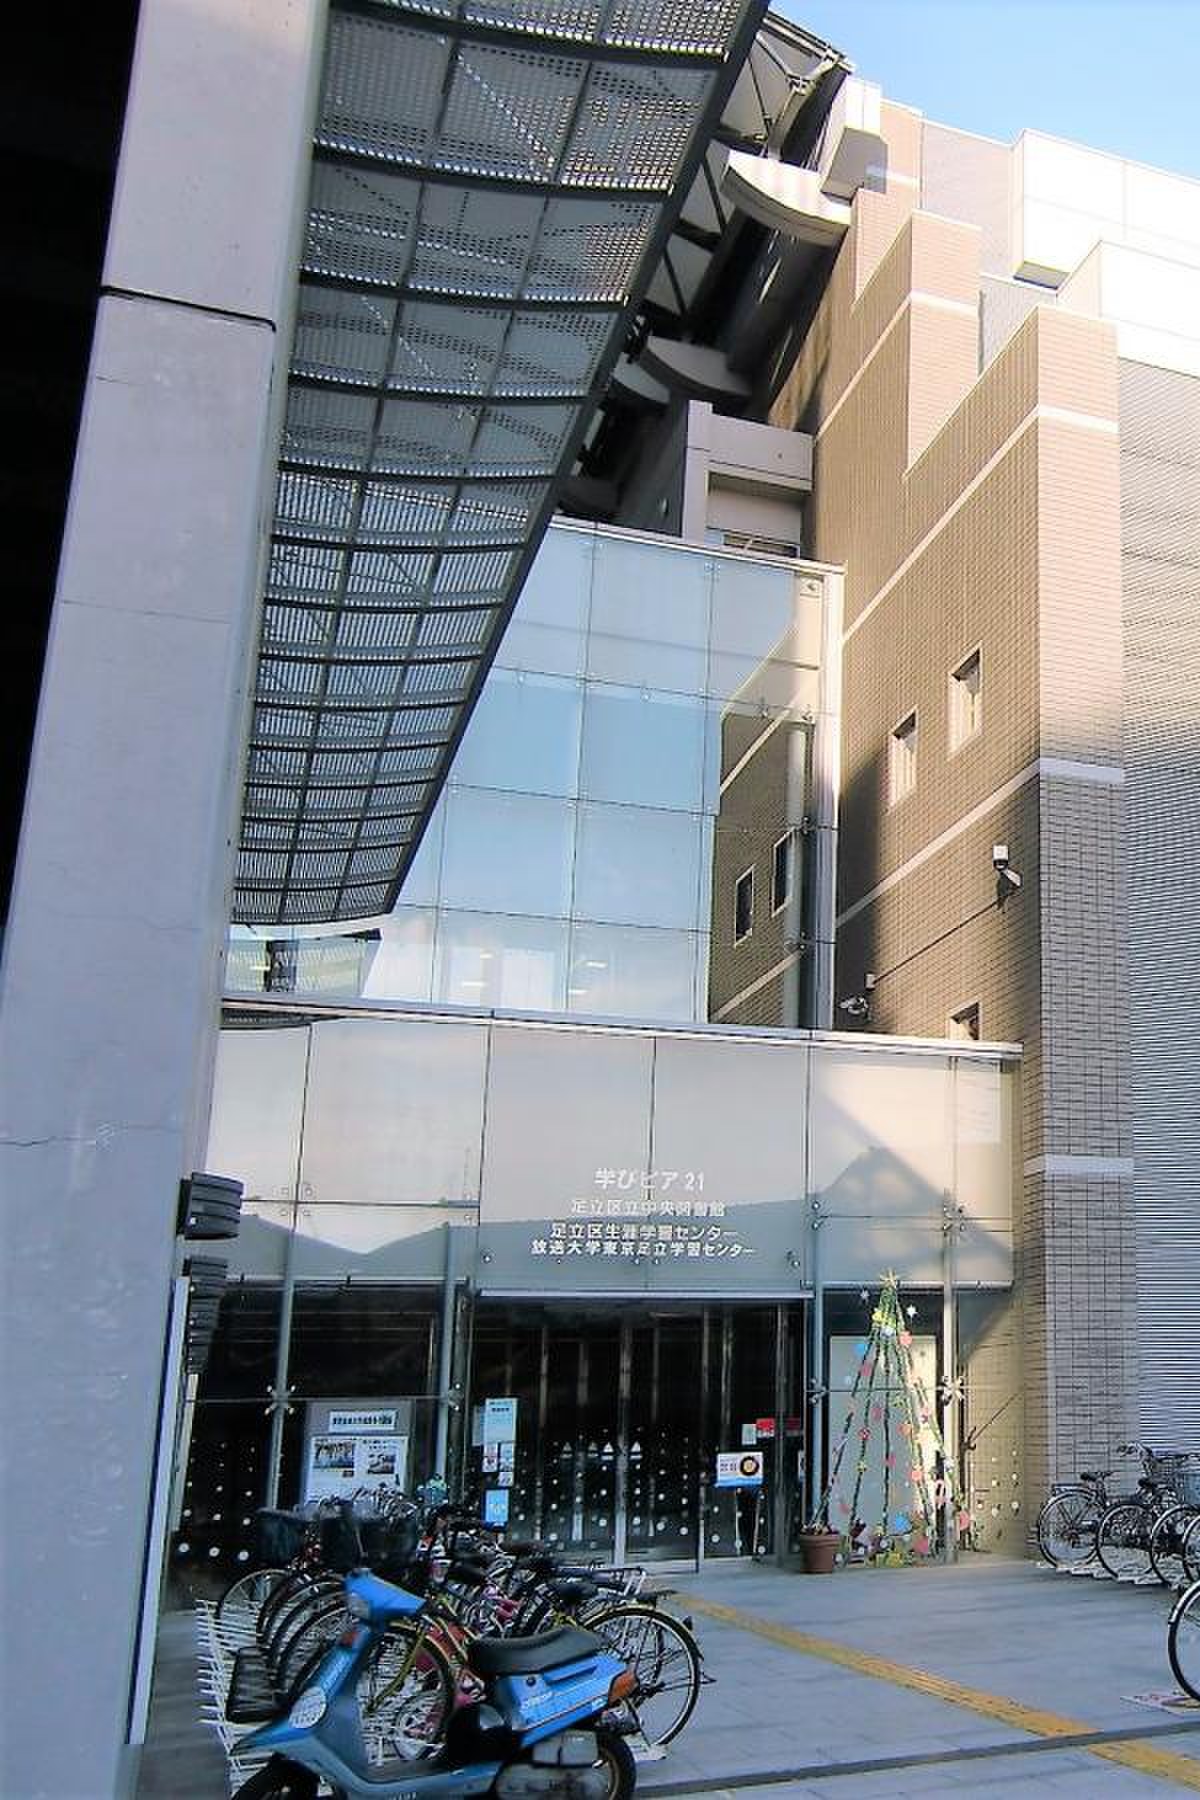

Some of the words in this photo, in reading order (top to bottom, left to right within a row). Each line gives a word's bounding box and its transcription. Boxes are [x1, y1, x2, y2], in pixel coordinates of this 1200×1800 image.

[595, 1168, 678, 1191] 学びピア
[685, 1171, 705, 1192] 21
[550, 1223, 738, 1240] 足立区生涯学習センター
[531, 1240, 754, 1257] 放送大学東京足立学習センター
